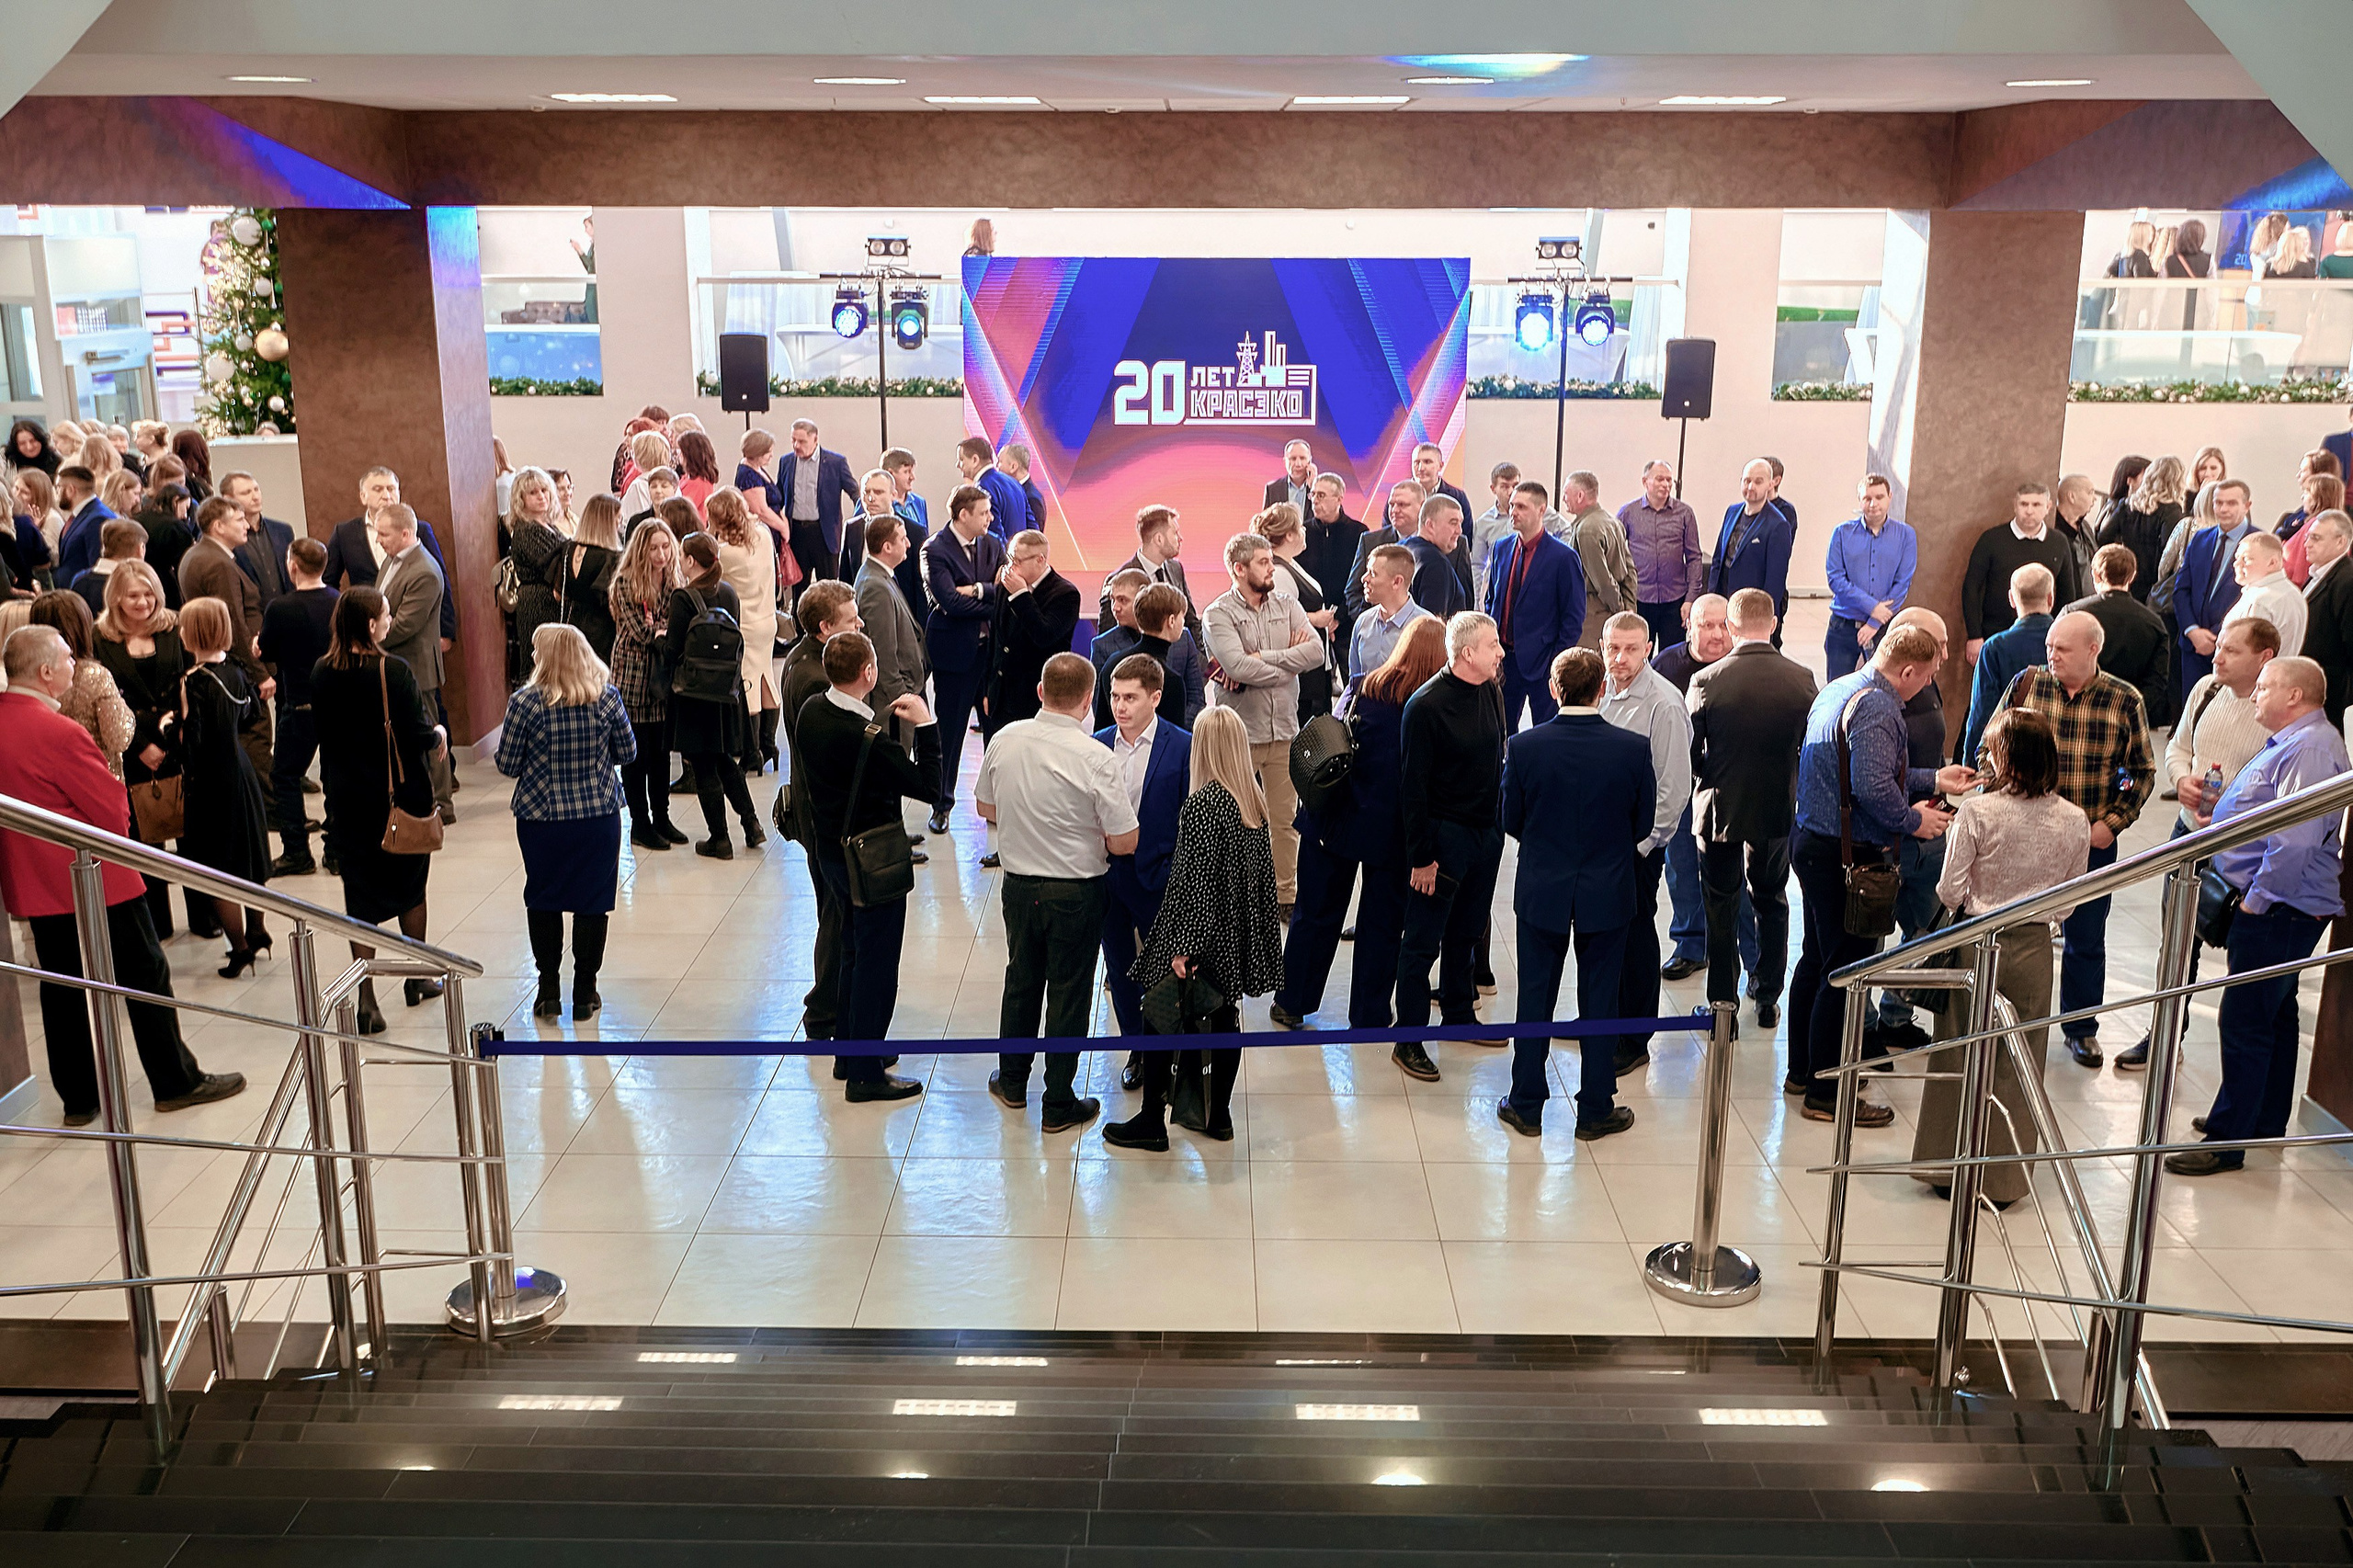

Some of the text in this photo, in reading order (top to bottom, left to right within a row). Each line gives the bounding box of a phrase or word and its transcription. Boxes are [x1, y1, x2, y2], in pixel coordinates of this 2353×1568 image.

[1114, 359, 1235, 425] 20 ЛЕТ
[1190, 390, 1302, 417] КРАСЭКО
